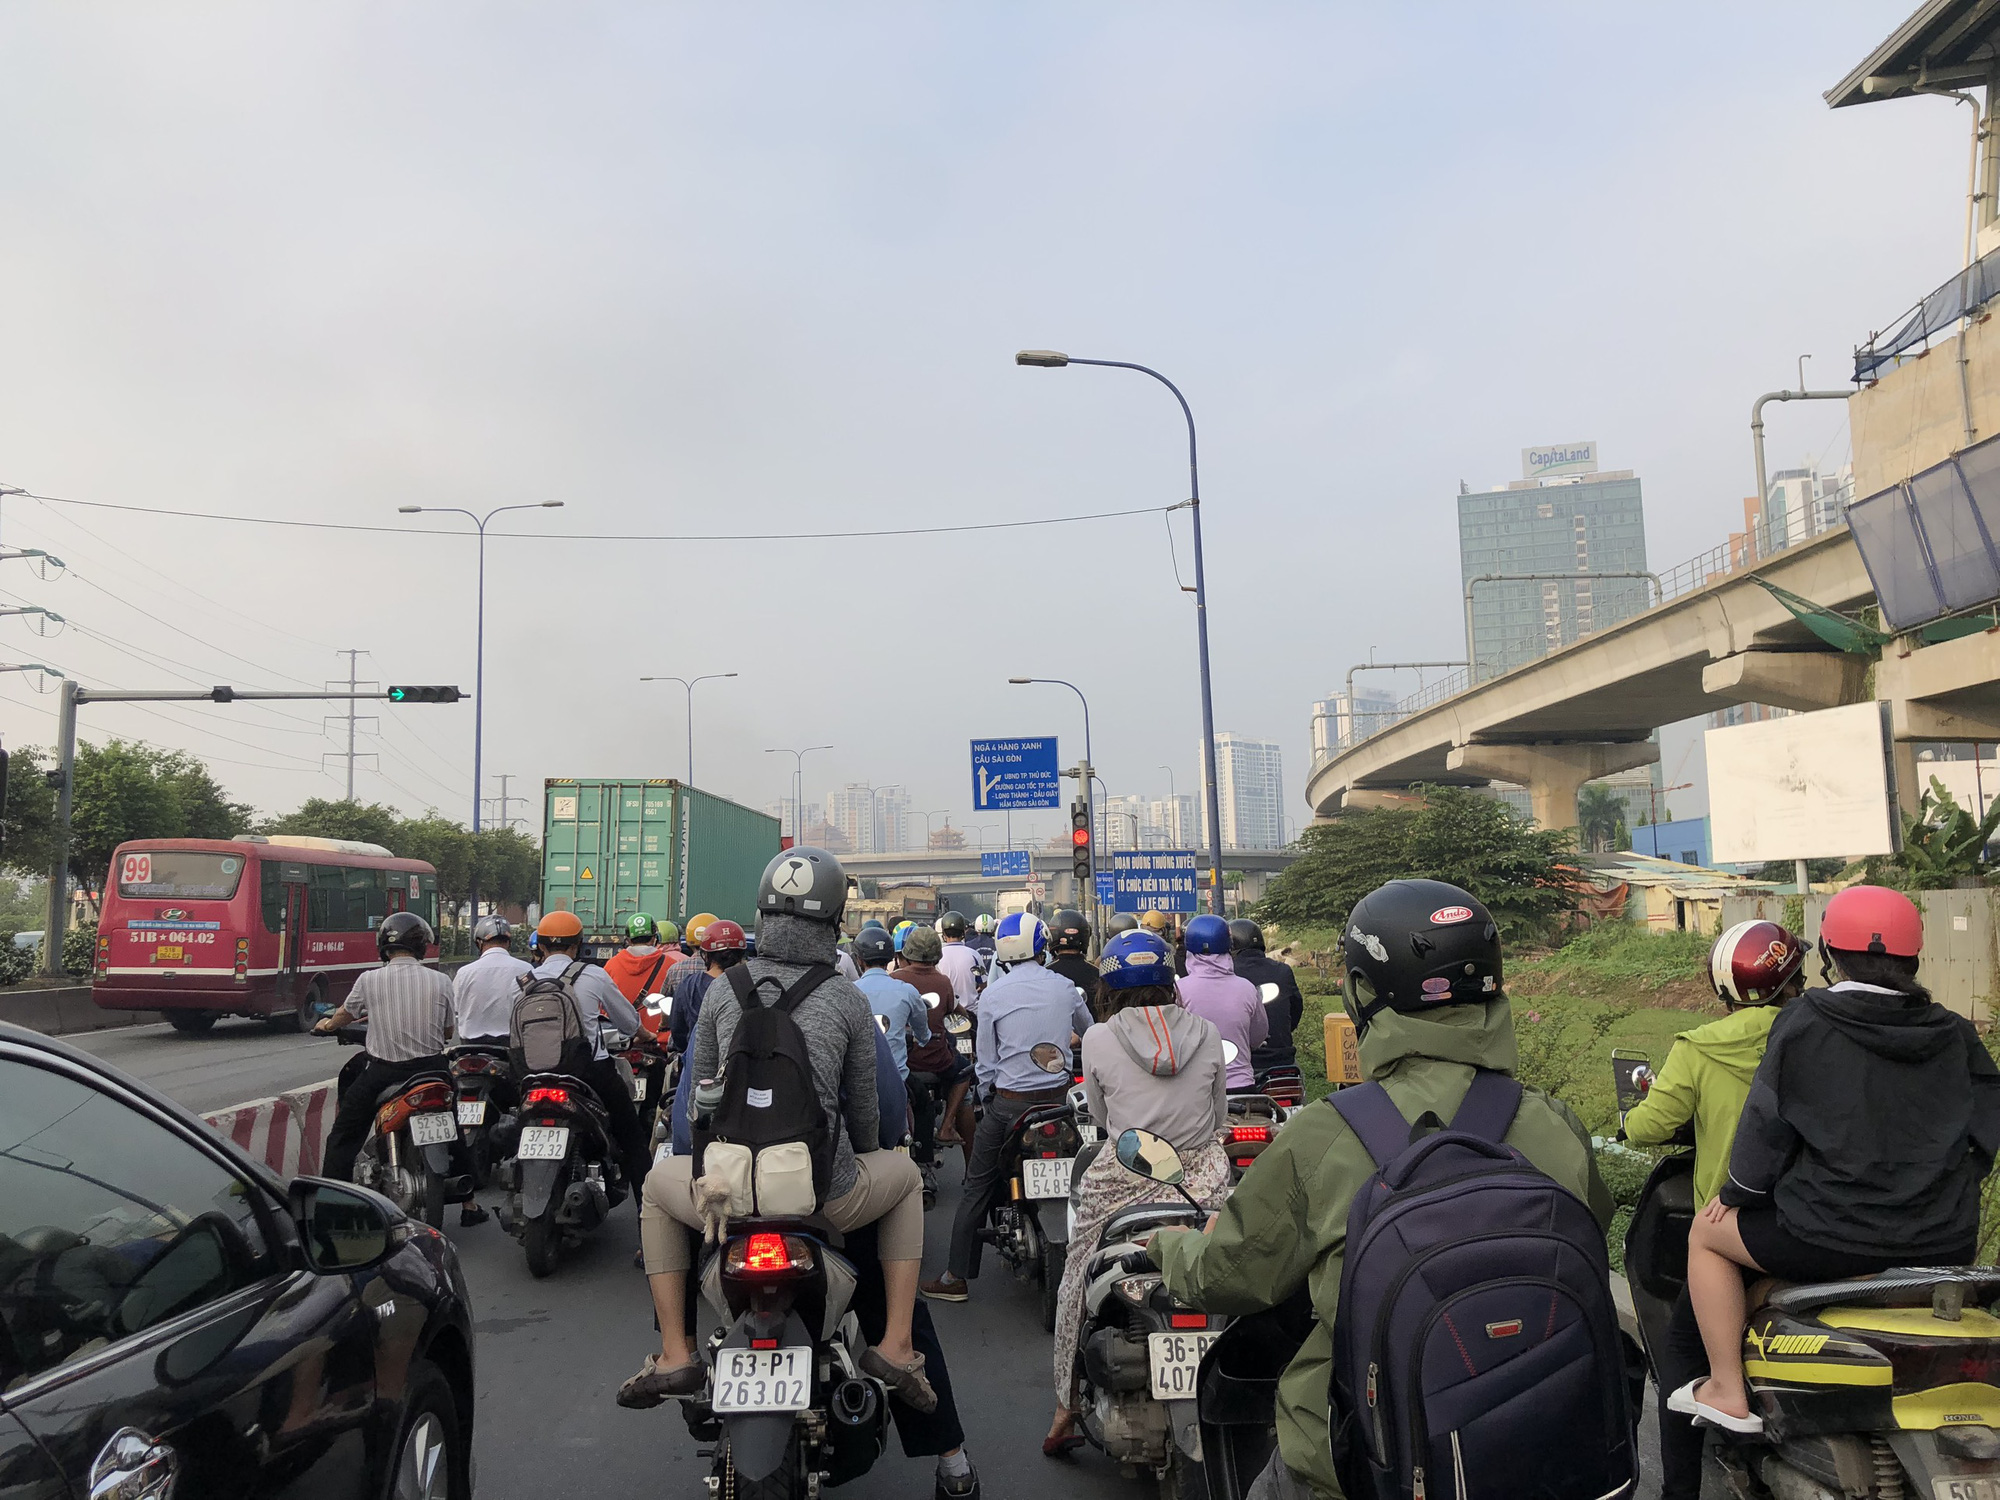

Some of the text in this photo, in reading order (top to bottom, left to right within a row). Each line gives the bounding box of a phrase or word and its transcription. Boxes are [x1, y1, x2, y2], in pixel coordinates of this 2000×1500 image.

[1529, 446, 1590, 467] CapitaLand
[974, 742, 990, 752] NGÃ
[998, 742, 1019, 751] HÀNG
[1022, 742, 1042, 750] XANH
[992, 754, 1004, 763] SÀI
[1006, 753, 1022, 762] GÒN
[125, 857, 150, 881] 99
[1159, 878, 1170, 892] TRA
[1148, 896, 1156, 910] XE
[130, 932, 215, 944] 51B 064.02
[458, 1103, 480, 1114] 0-X1
[417, 1115, 448, 1129] 52-S6
[420, 1127, 450, 1144] 2448
[529, 1129, 560, 1143] 37-P1
[521, 1144, 562, 1157] 352.32
[1032, 1161, 1068, 1178] 62-P1
[1033, 1179, 1070, 1195] 5485
[1163, 1336, 1217, 1362] 36-B
[1767, 1334, 1830, 1354] PUMA
[731, 1352, 794, 1378] 63-P1
[720, 1380, 804, 1406] 263.02
